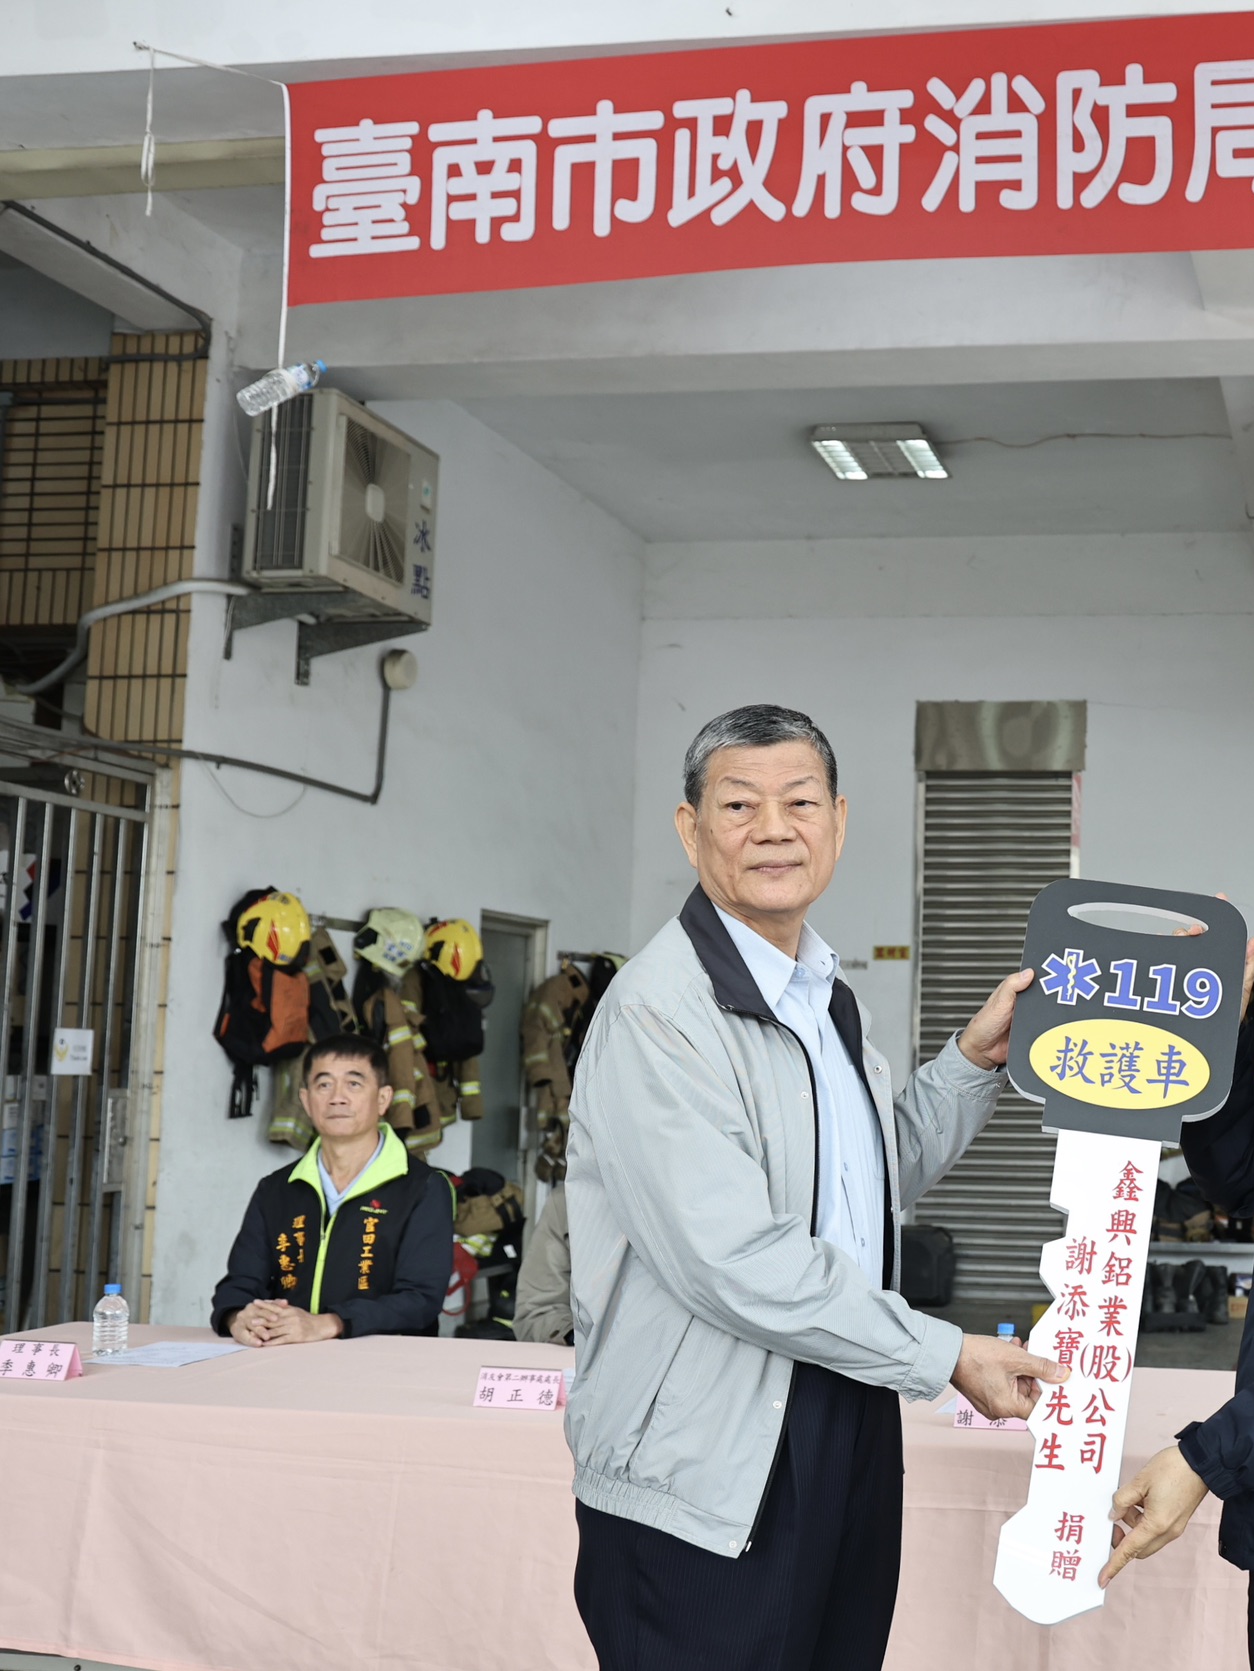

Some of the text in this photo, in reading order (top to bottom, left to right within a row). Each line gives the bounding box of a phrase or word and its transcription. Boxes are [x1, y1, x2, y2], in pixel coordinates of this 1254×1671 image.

[1103, 958, 1223, 1019] 119
[1050, 1036, 1189, 1099] 救護車
[1079, 1160, 1145, 1474] 鑫興鋁業(股)公司
[12, 1342, 60, 1357] 理事長
[1034, 1236, 1098, 1471] 謝添寶先生
[479, 1386, 554, 1406] 胡正德
[1048, 1511, 1085, 1581] 捐贈
